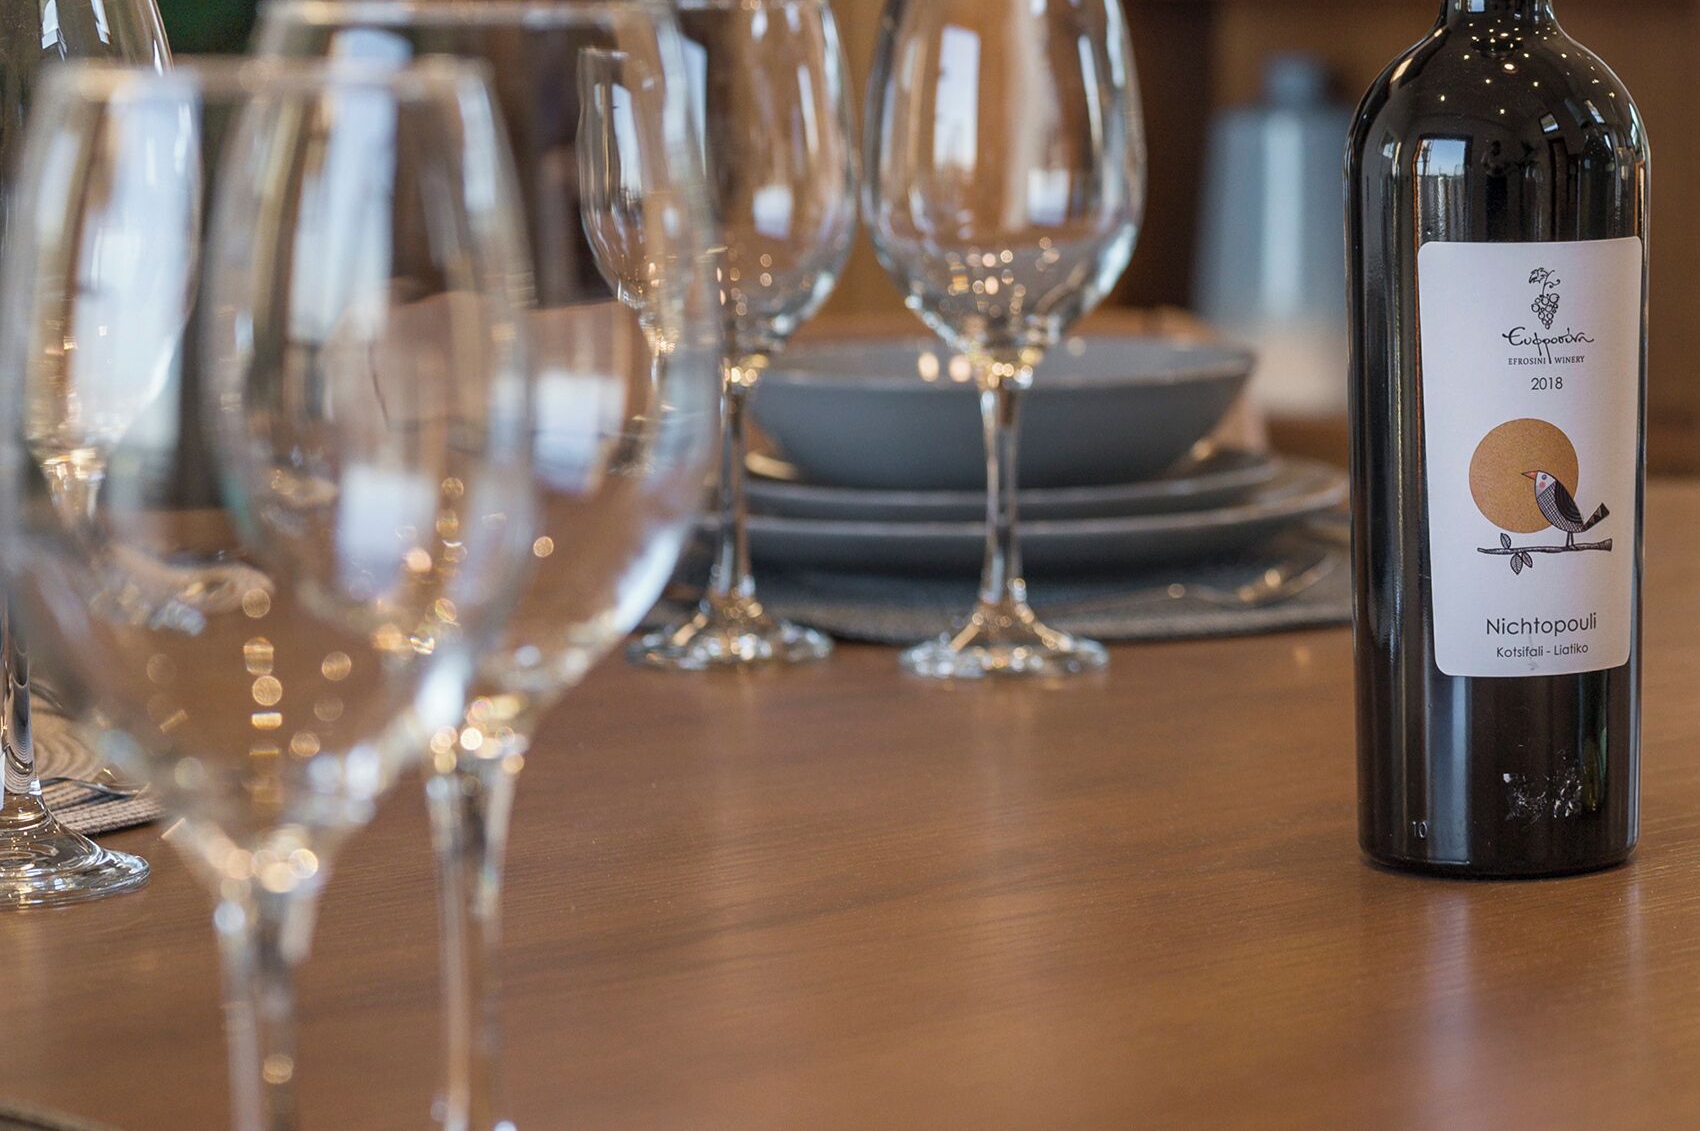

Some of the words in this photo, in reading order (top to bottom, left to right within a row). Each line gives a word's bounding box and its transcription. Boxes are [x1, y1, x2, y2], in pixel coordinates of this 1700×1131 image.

[1508, 357, 1546, 365] EFROSINI
[1555, 355, 1585, 364] WINERY
[1531, 377, 1563, 390] 2018
[1486, 612, 1597, 638] Nichtopouli
[1496, 645, 1544, 658] Kotsifali
[1553, 643, 1589, 656] Liatiko
